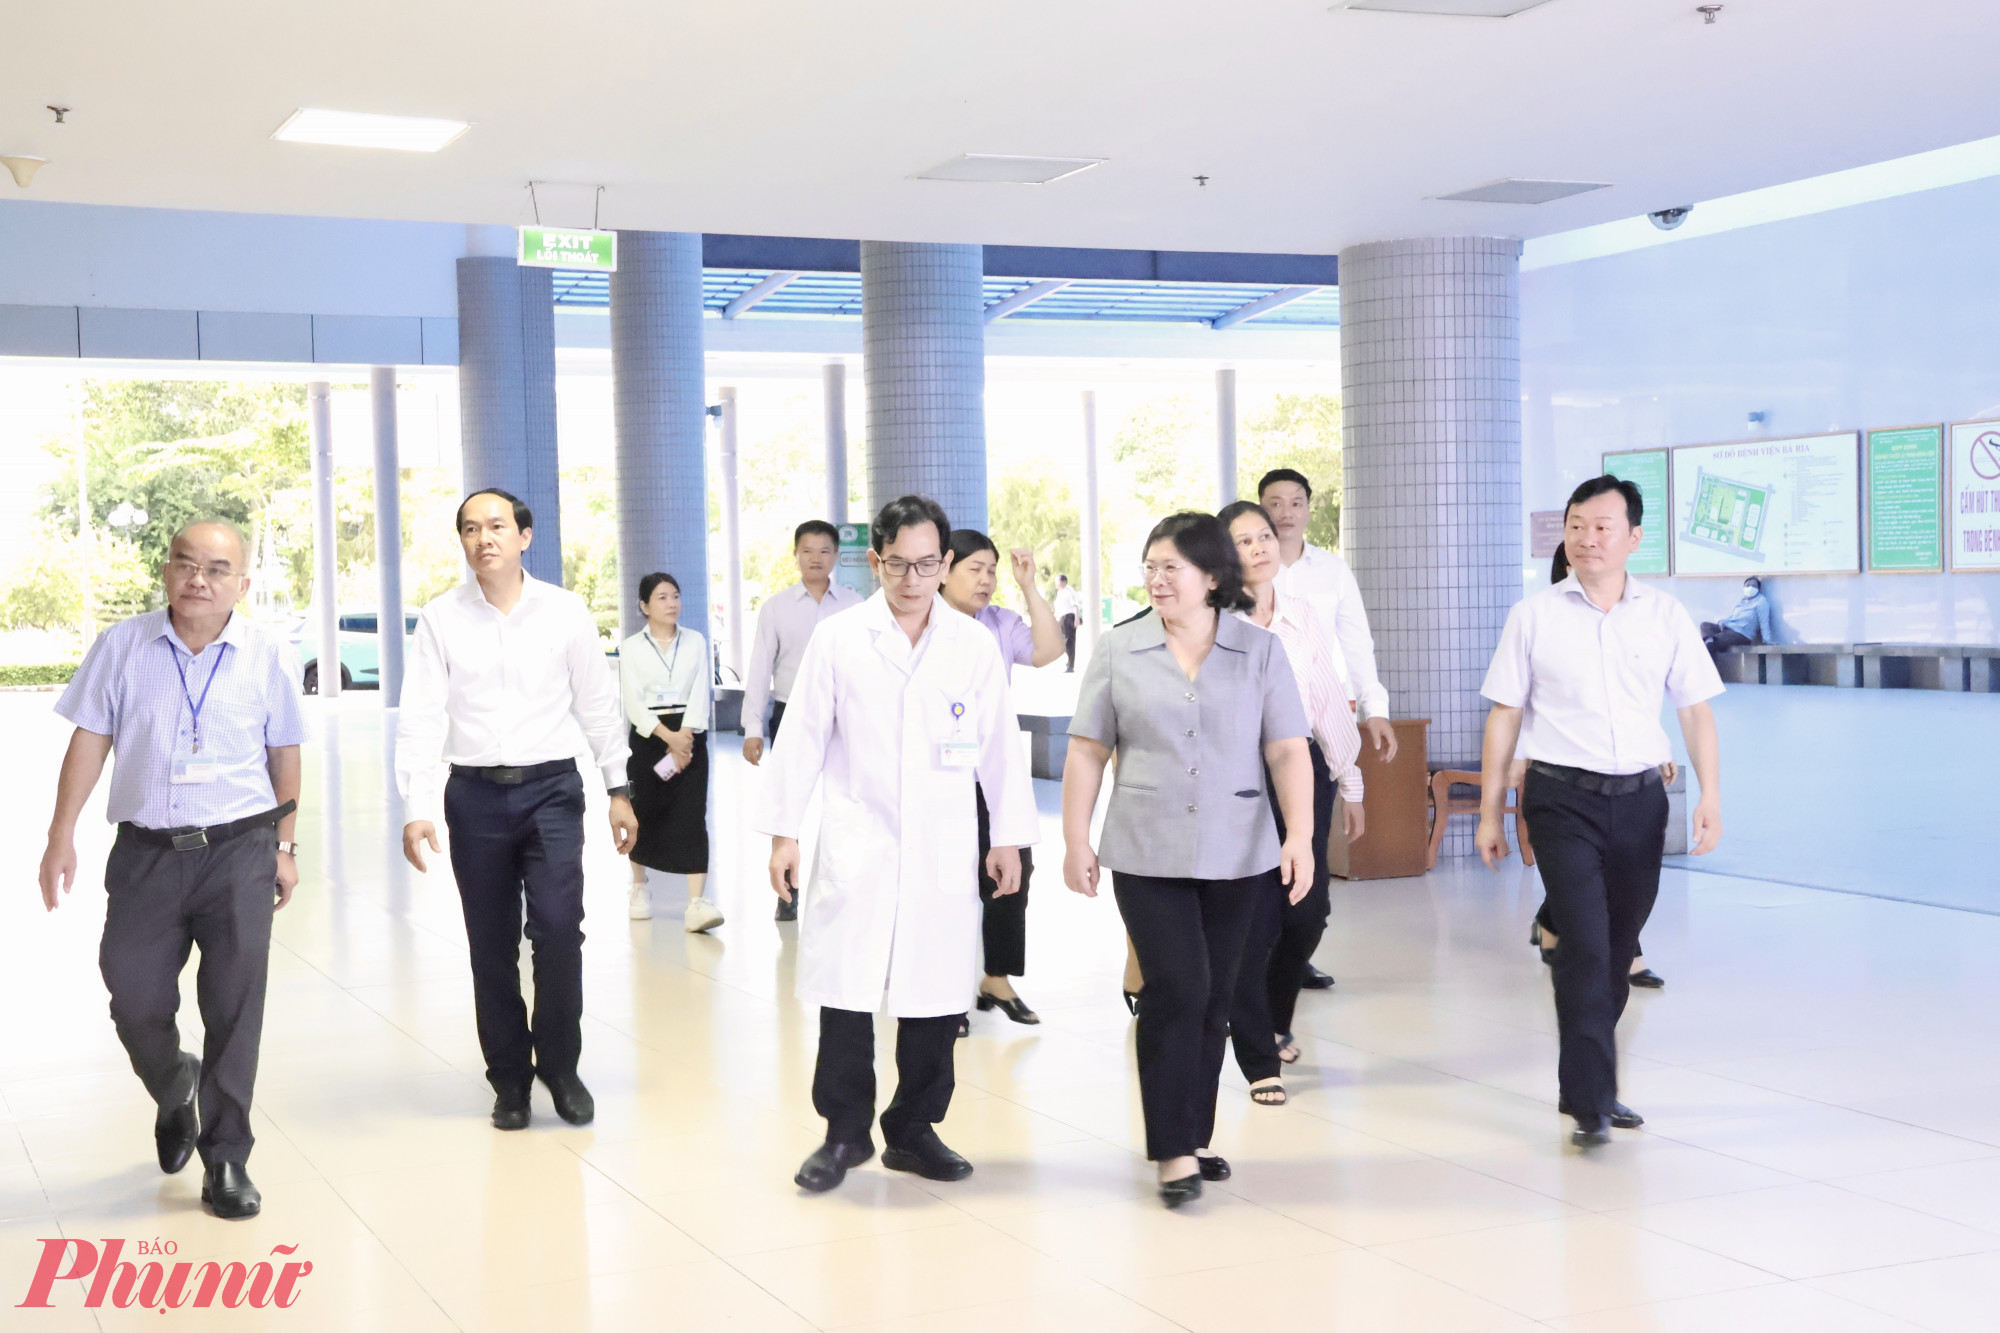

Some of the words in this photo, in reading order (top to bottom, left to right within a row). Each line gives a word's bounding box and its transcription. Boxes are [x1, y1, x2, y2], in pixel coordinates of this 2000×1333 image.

[542, 232, 594, 250] EXIT
[536, 247, 558, 261] LỐI
[560, 250, 600, 264] THOÁT
[1960, 483, 1975, 514] CẤM
[1976, 484, 1989, 513] HÚT
[1963, 529, 1983, 552] TRONG
